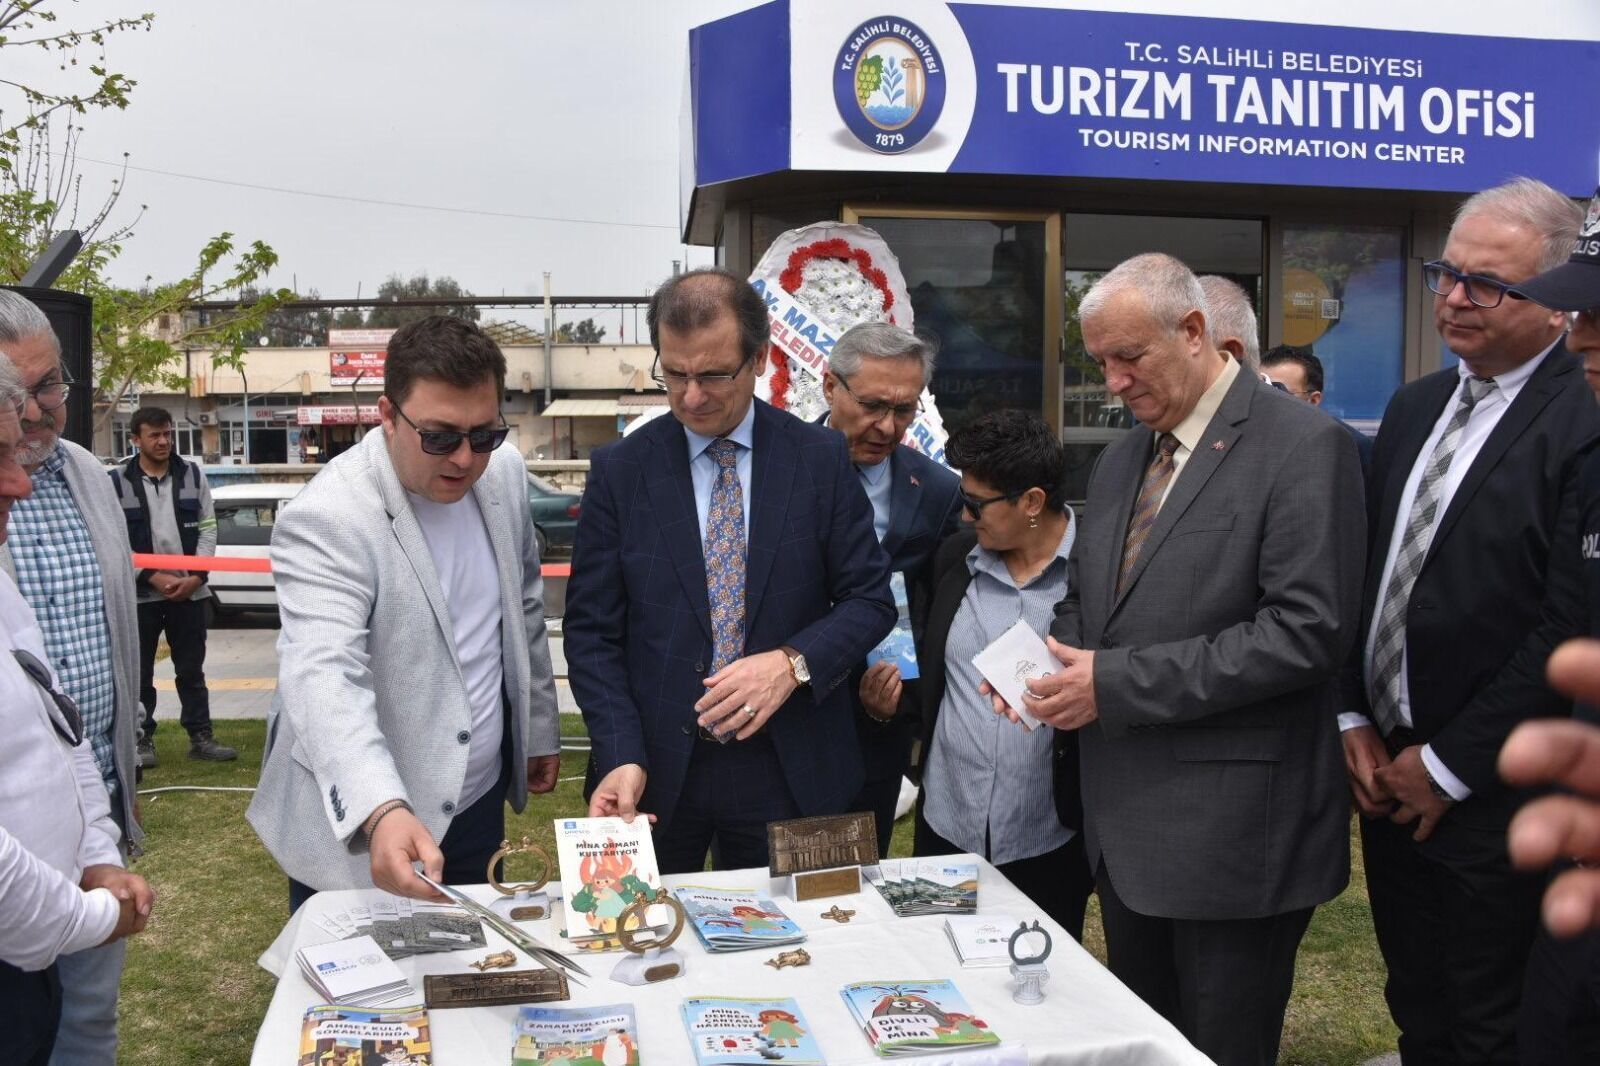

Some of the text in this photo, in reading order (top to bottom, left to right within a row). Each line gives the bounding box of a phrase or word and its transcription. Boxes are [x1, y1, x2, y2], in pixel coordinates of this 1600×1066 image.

[1125, 42, 1168, 62] T.C.
[842, 53, 856, 70] T.C.
[1207, 74, 1405, 132] TANITIM
[875, 133, 904, 147] 1879
[1078, 128, 1465, 164] TOURISM INFORMATION CENTER
[887, 1031, 930, 1040] MİNA
